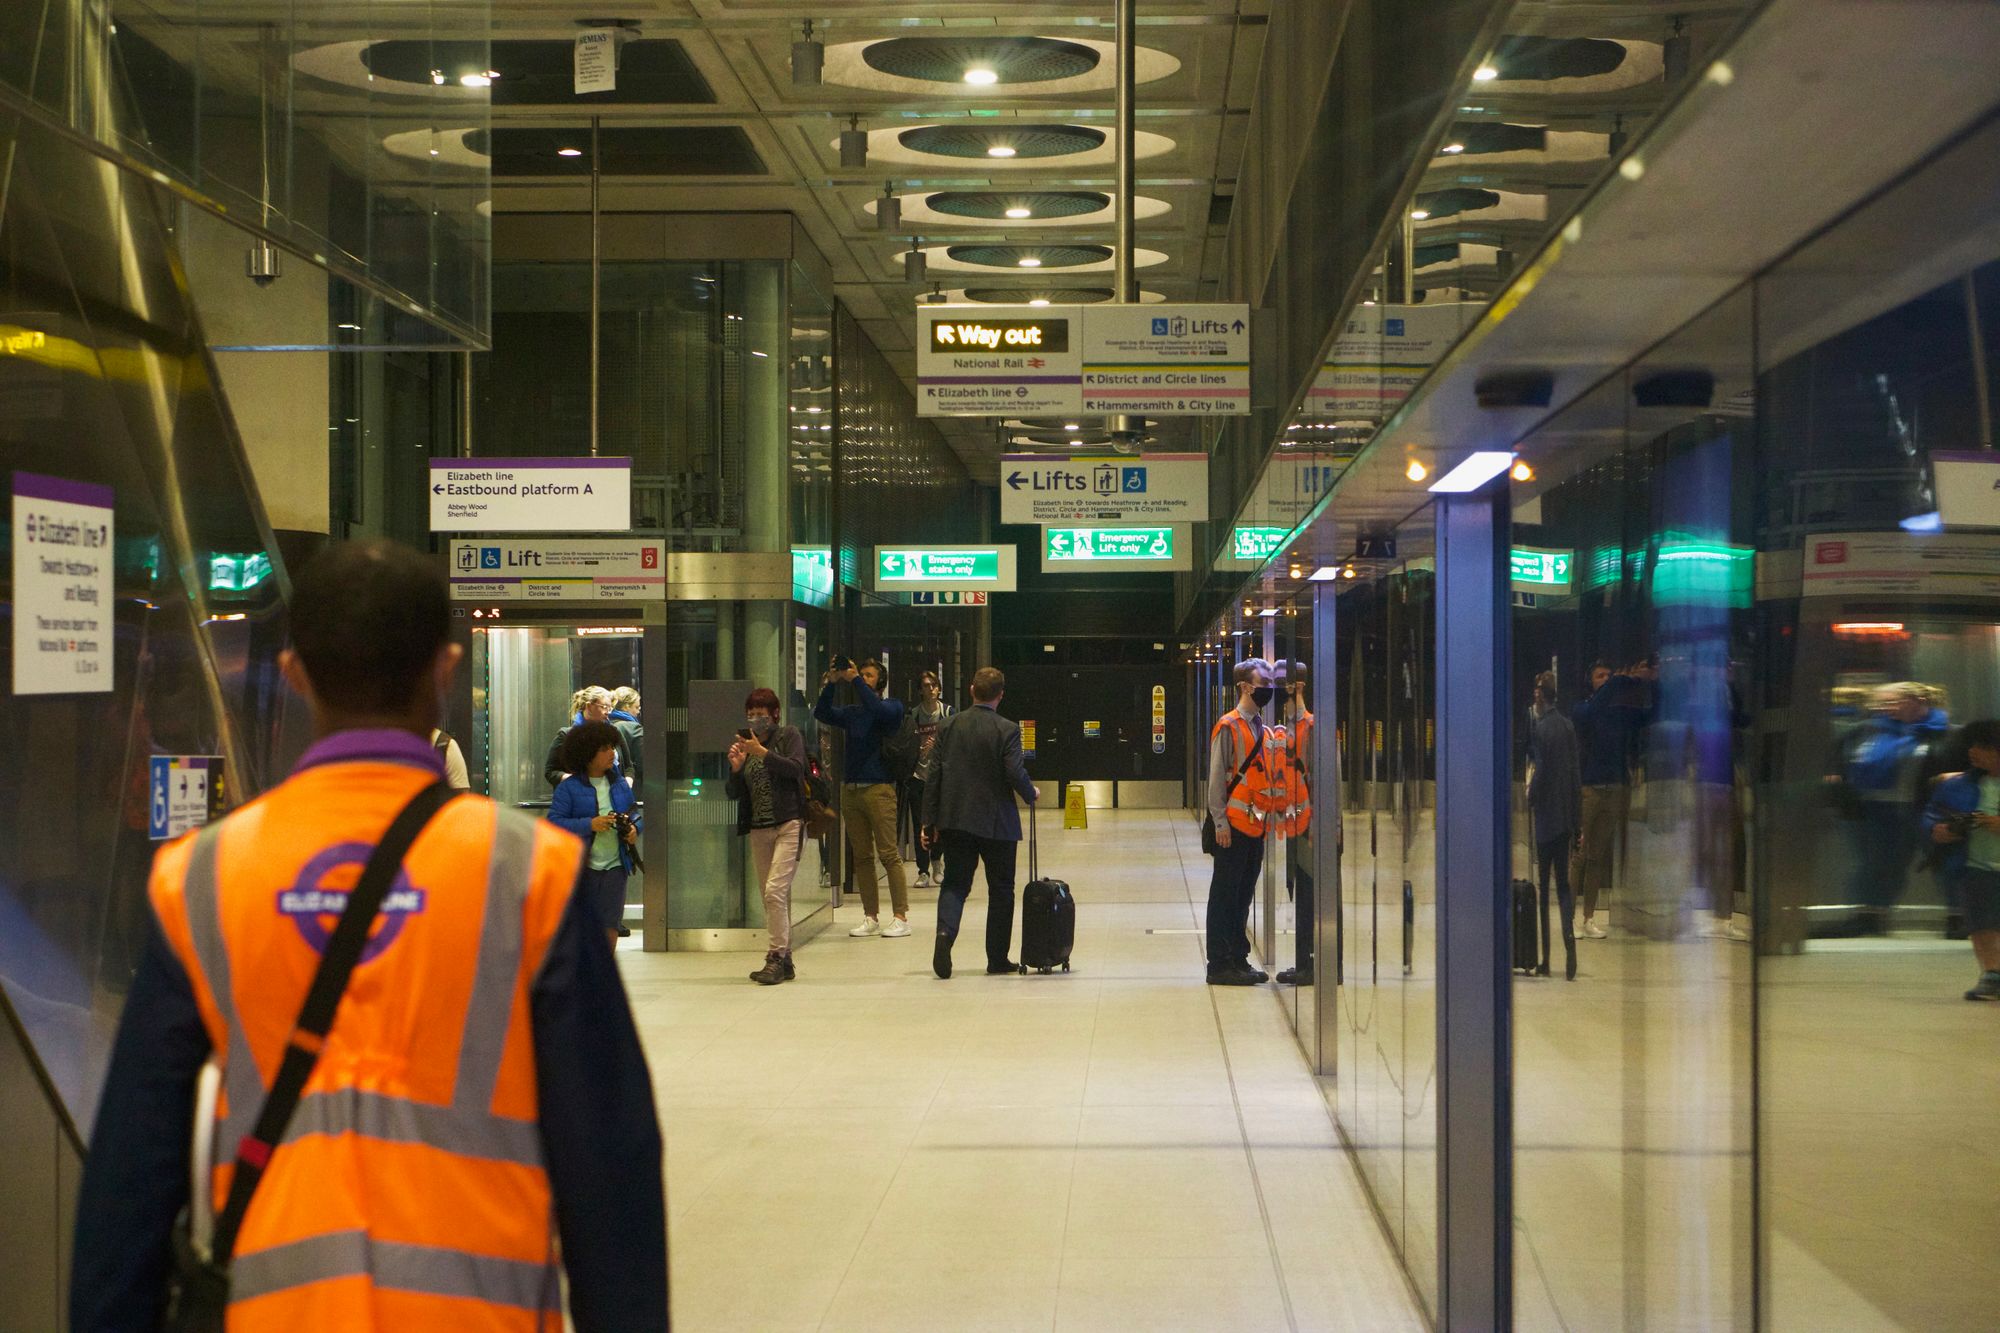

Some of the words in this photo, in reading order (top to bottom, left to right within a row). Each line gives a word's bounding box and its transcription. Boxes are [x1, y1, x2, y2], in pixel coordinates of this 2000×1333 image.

[1192, 320, 1228, 334] Lifts
[957, 325, 1001, 348] Way
[1005, 326, 1042, 344] out
[954, 358, 1000, 368] National
[1004, 358, 1024, 368] Rail
[1097, 374, 1138, 384] District
[1142, 374, 1162, 384] and
[1166, 374, 1197, 384] Circle
[1200, 374, 1226, 384] lines
[938, 388, 988, 398] Elizabeth
[992, 388, 1012, 398] line
[1097, 401, 1174, 410] Hammersmith
[1177, 401, 1185, 410] &
[1189, 401, 1211, 412] City
[1215, 400, 1235, 409] line
[448, 472, 492, 481] Elizabeth
[495, 472, 514, 481] line
[1033, 471, 1087, 490] Lifts
[448, 484, 517, 495] Eastbound
[522, 484, 579, 497] platform
[583, 484, 593, 495] A
[1099, 534, 1150, 545] Emergency
[1099, 544, 1116, 552] Lift
[1120, 544, 1140, 555] only
[1362, 541, 1370, 555] 7
[507, 549, 542, 567] Lift
[645, 555, 654, 567] 9
[928, 555, 976, 566] Emergency
[928, 566, 953, 574] stairs
[955, 565, 974, 576] only
